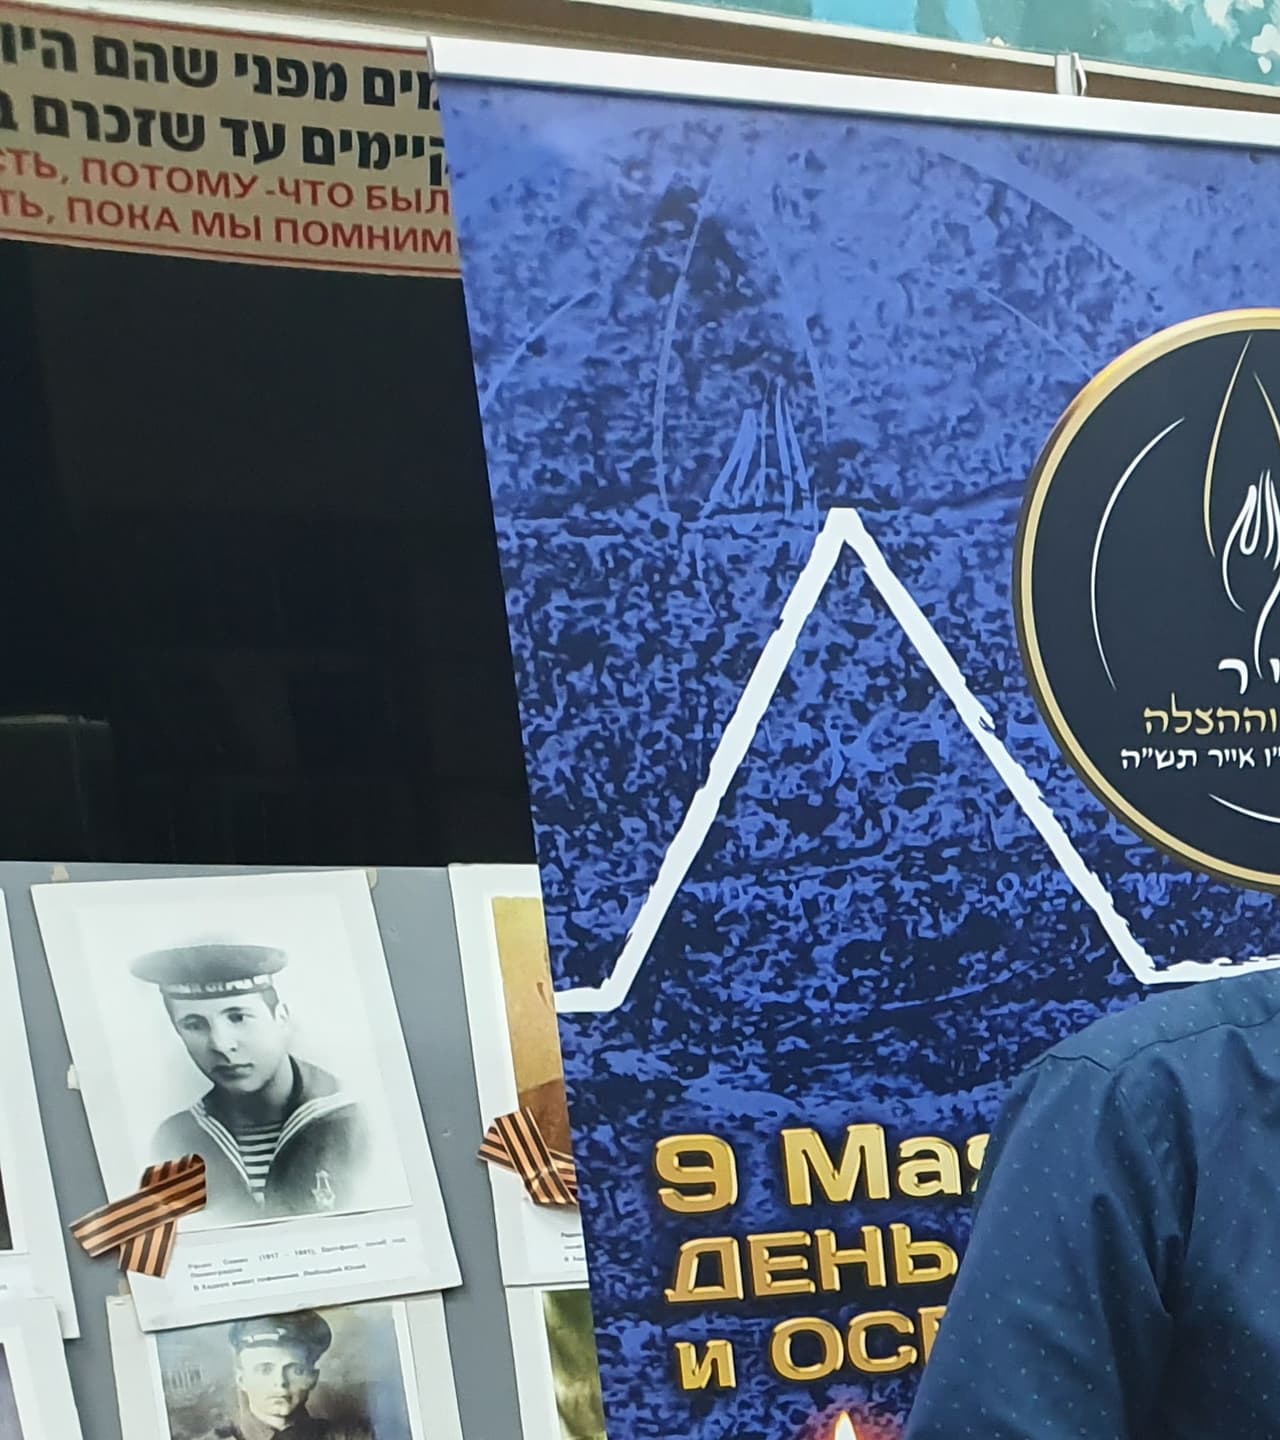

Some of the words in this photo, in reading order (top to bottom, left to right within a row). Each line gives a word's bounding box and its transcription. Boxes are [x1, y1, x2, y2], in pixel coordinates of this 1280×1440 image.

[93, 35, 218, 87] שהם
[234, 52, 348, 101] מפני
[33, 94, 205, 153] שזכרם
[220, 117, 286, 165] עד
[81, 156, 259, 200] ПОТОМУ
[67, 197, 181, 235] ПОКА
[192, 209, 262, 243] МЫ
[274, 217, 453, 256] ПОМНИМ
[1143, 692, 1278, 736] וההצלה
[1207, 747, 1256, 769] אייר
[655, 1132, 739, 1214] 9
[664, 1222, 959, 1303] ДЕНЬ
[674, 1338, 737, 1391] и
